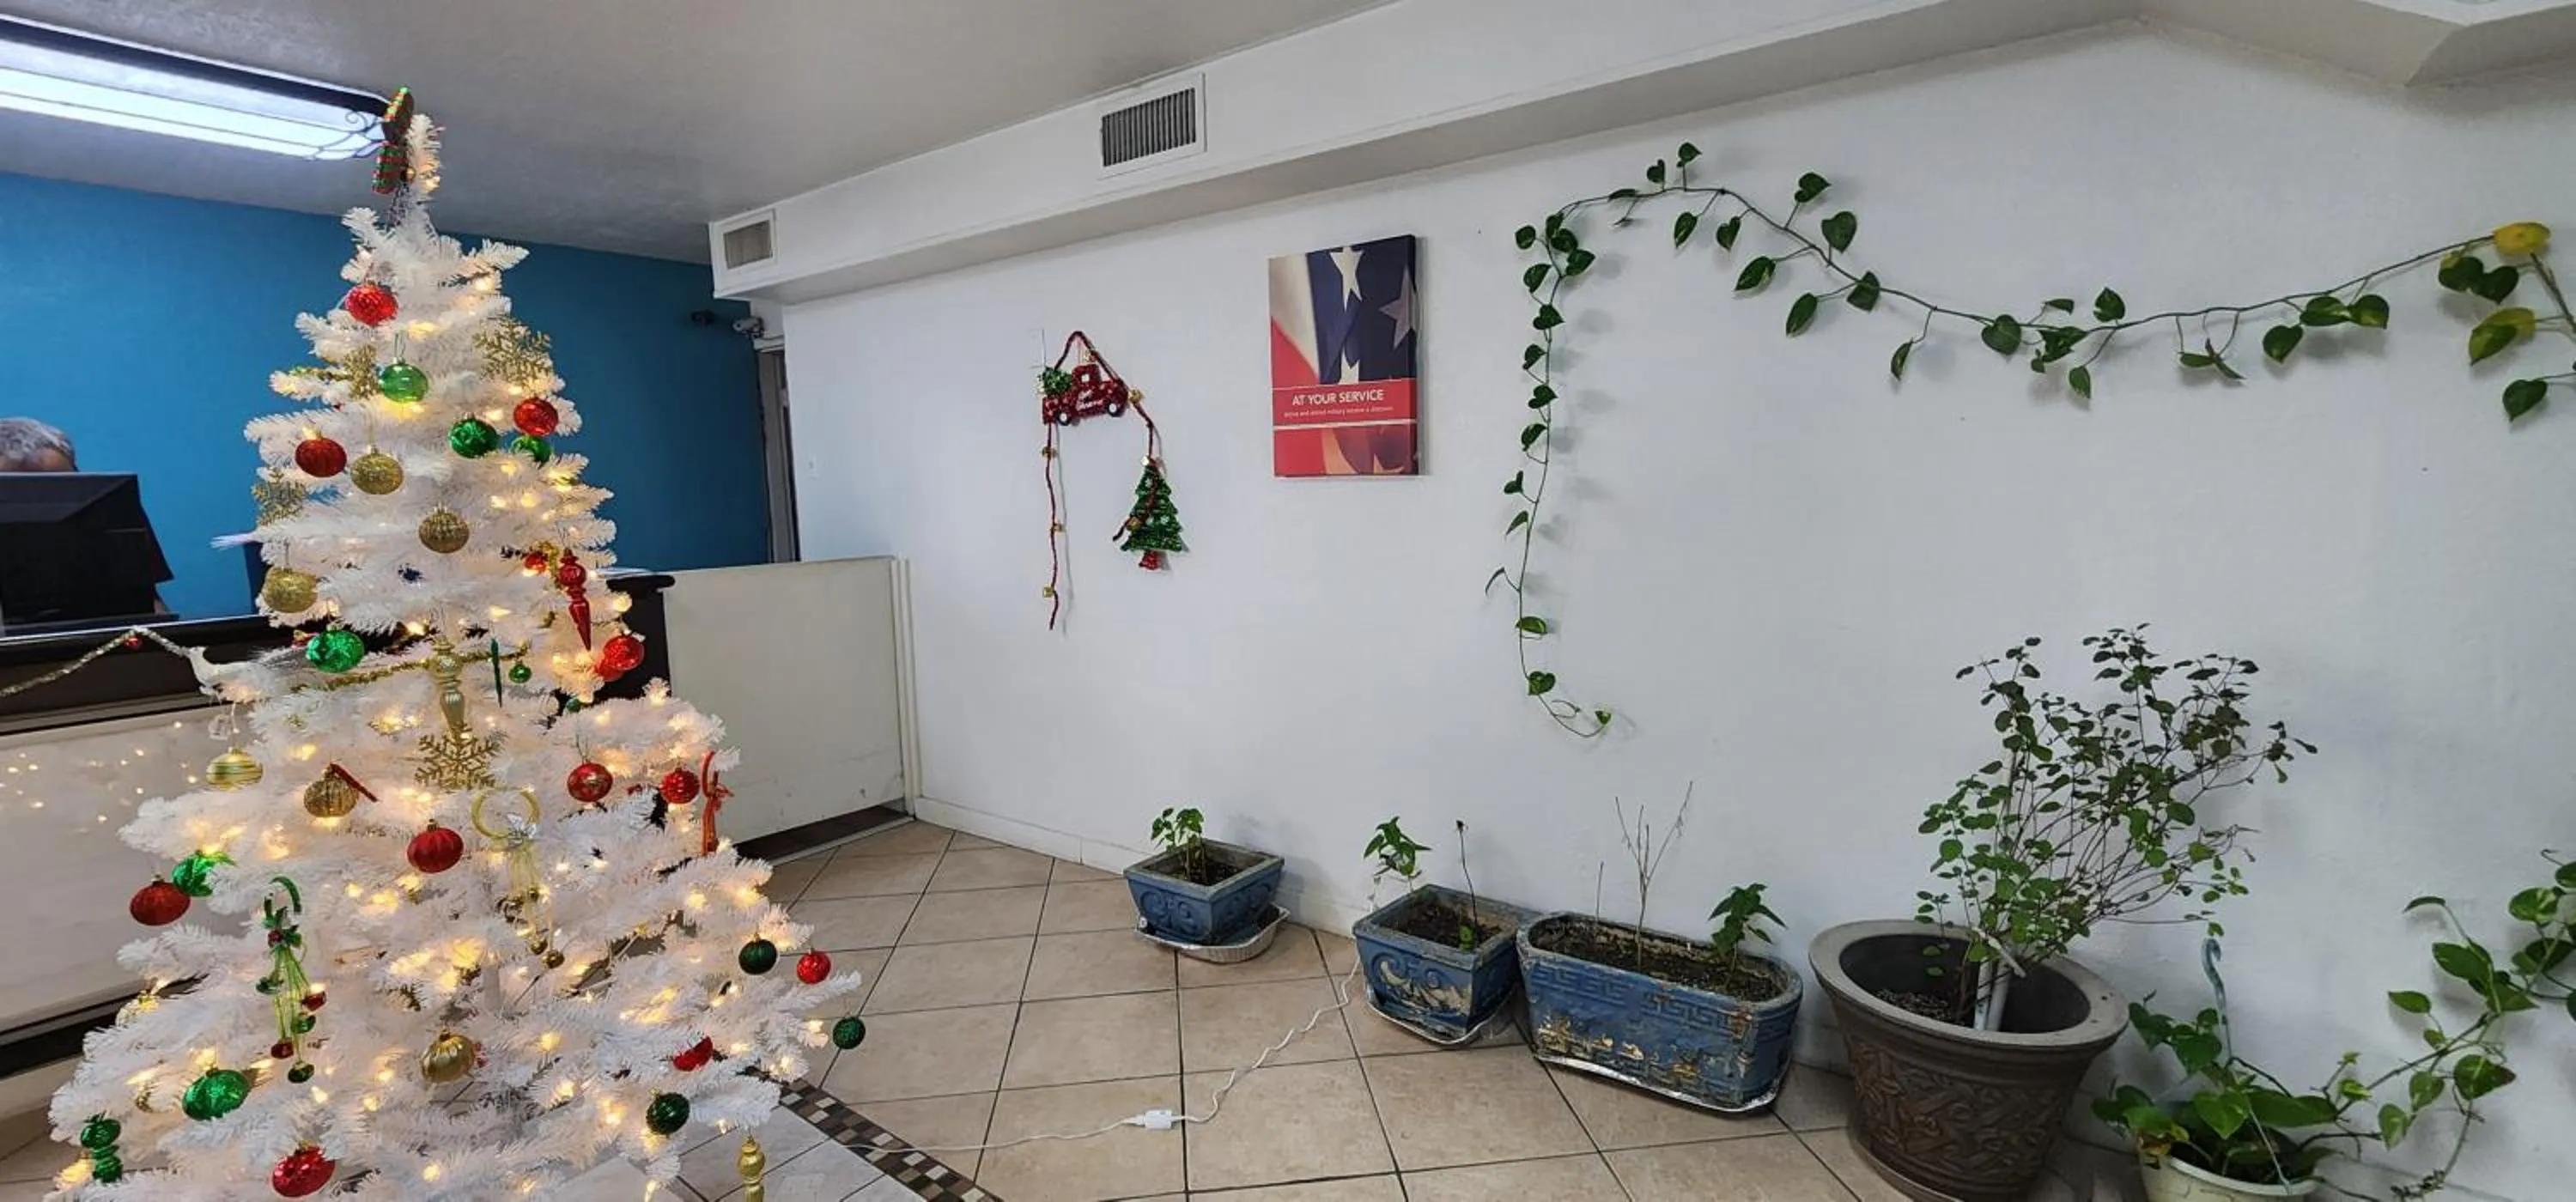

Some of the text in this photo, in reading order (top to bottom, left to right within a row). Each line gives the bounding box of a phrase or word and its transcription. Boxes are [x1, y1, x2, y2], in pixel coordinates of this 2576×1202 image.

[1291, 389, 1384, 406] AT YOUR SERVICE
